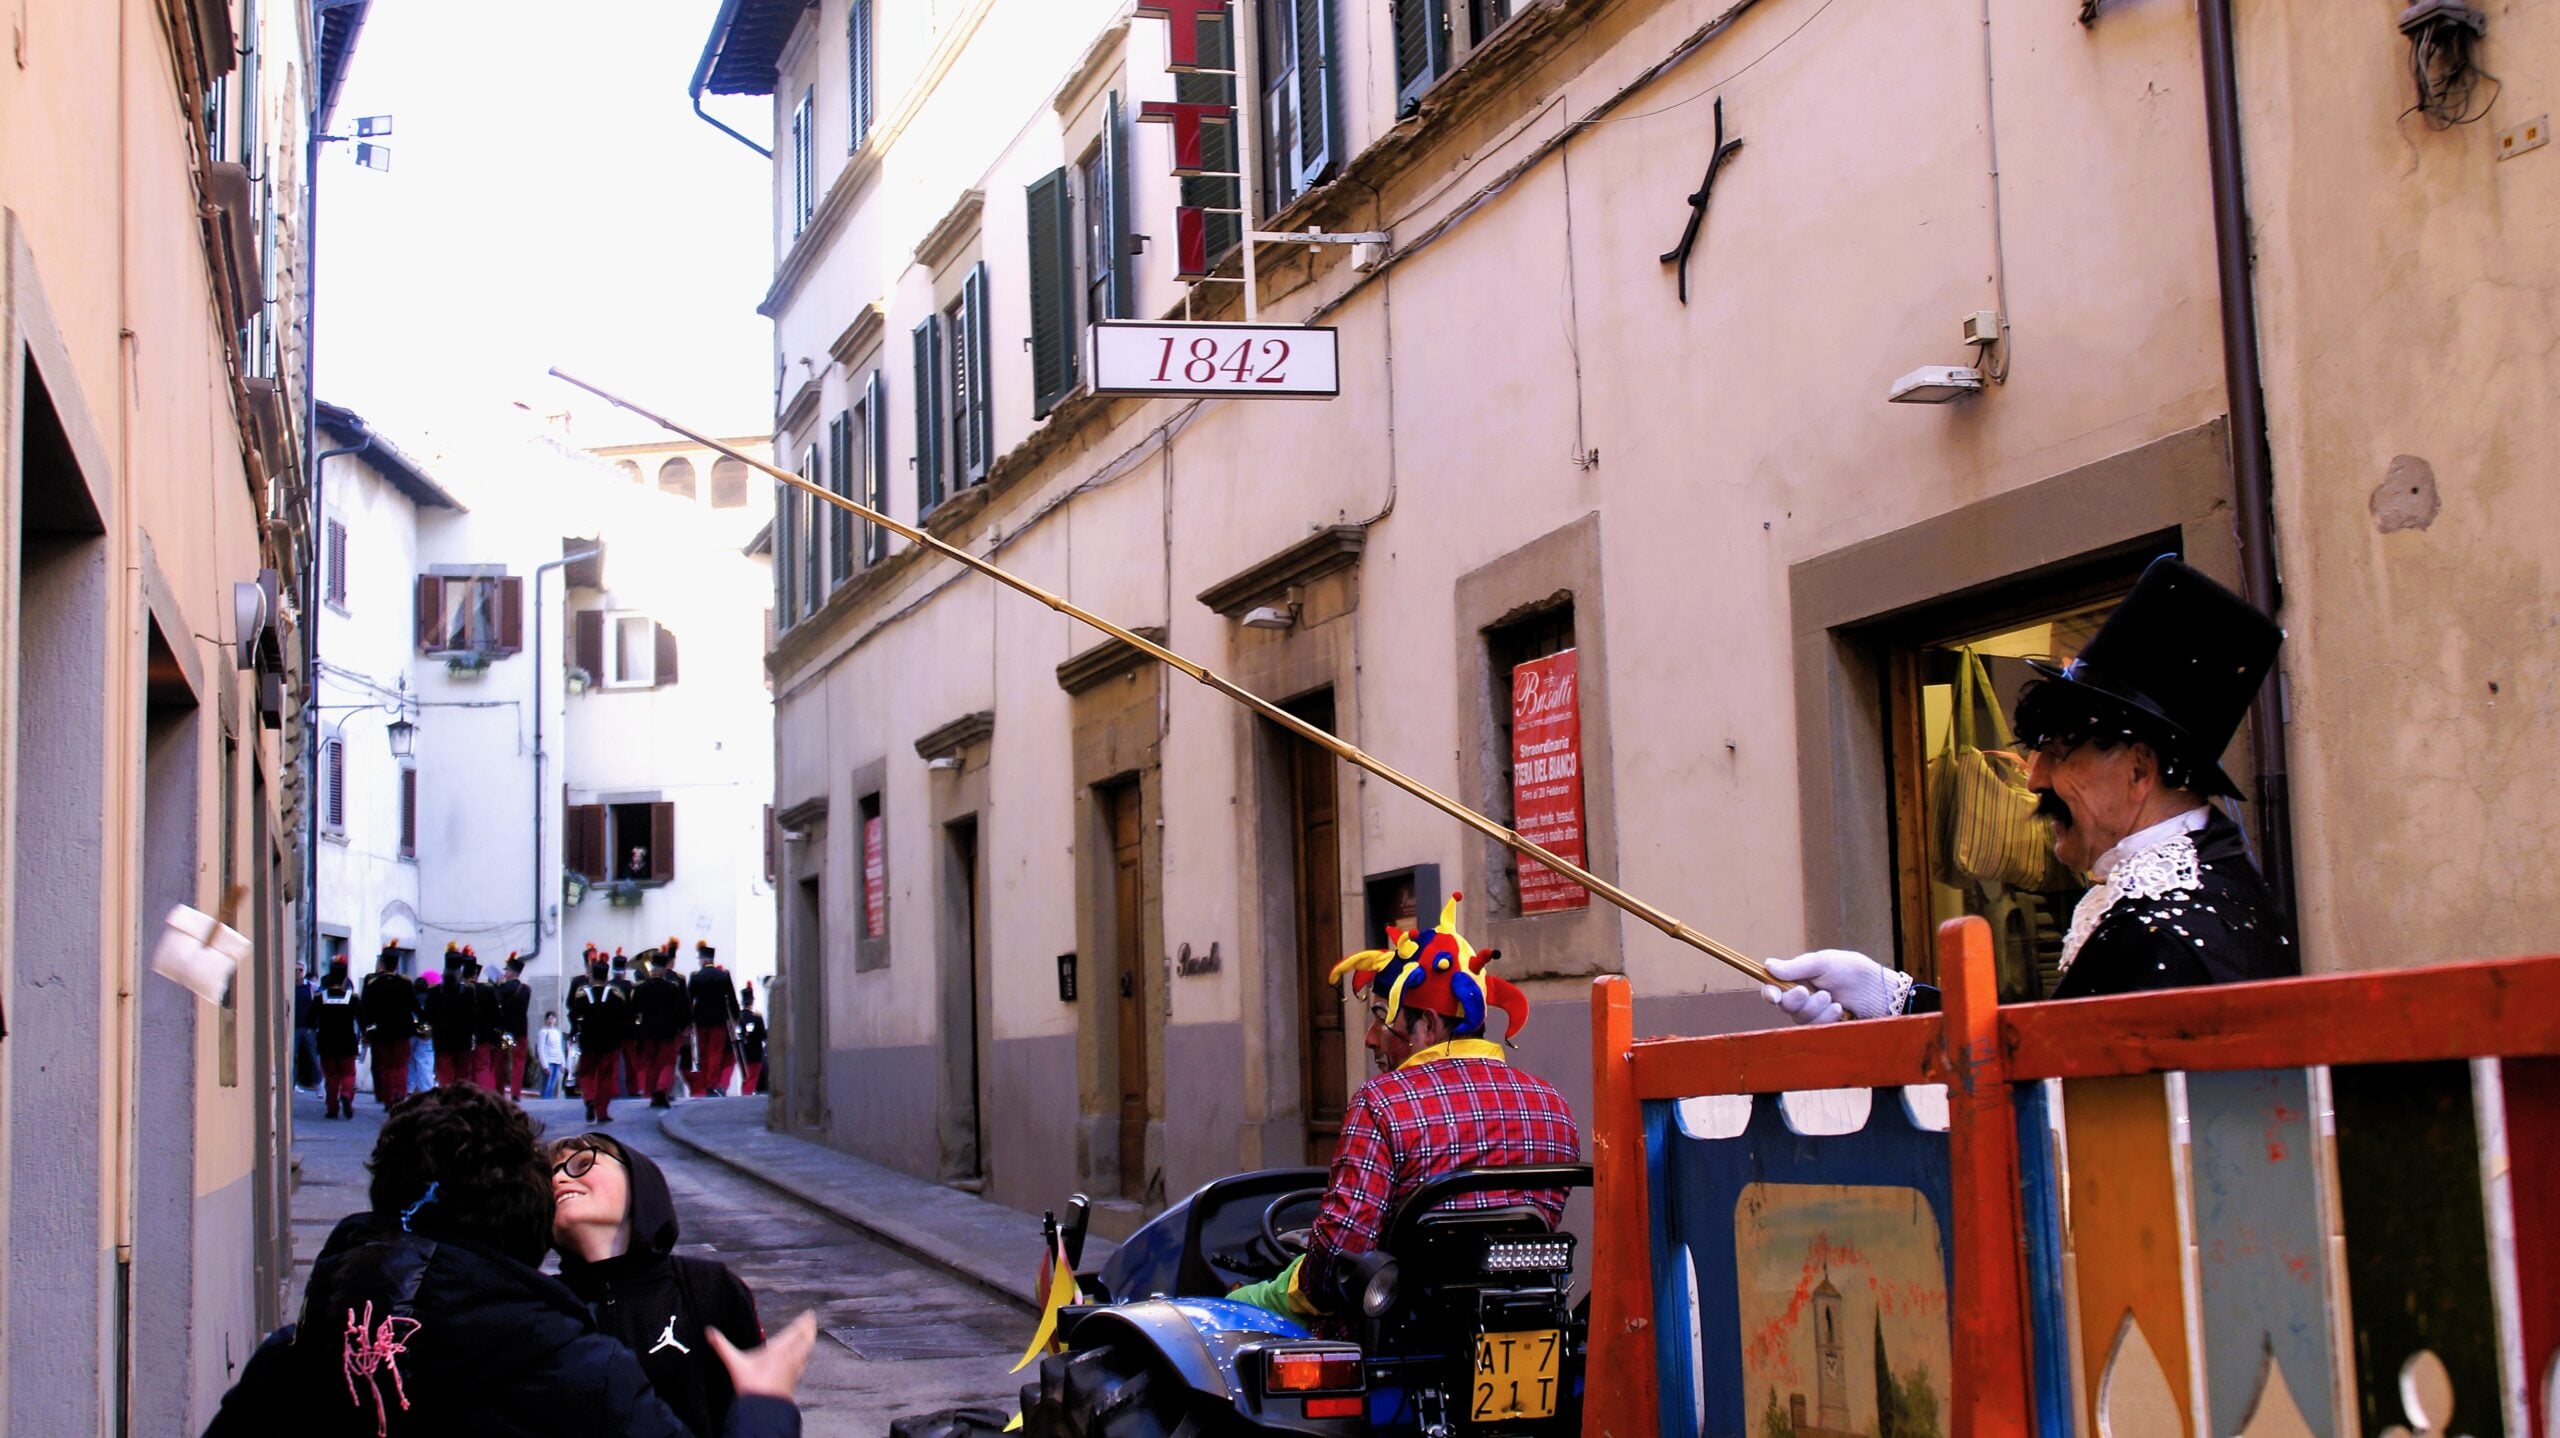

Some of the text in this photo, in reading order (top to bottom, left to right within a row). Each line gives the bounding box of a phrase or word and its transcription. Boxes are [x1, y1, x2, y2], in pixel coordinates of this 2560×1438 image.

[1150, 336, 1290, 384] 1842
[1516, 671, 1575, 717] Busatti
[1520, 735, 1569, 758] Straordinaria
[1534, 758, 1548, 783] DEL
[1549, 751, 1577, 781] BIANCO
[1479, 1334, 1557, 1376] AT 7
